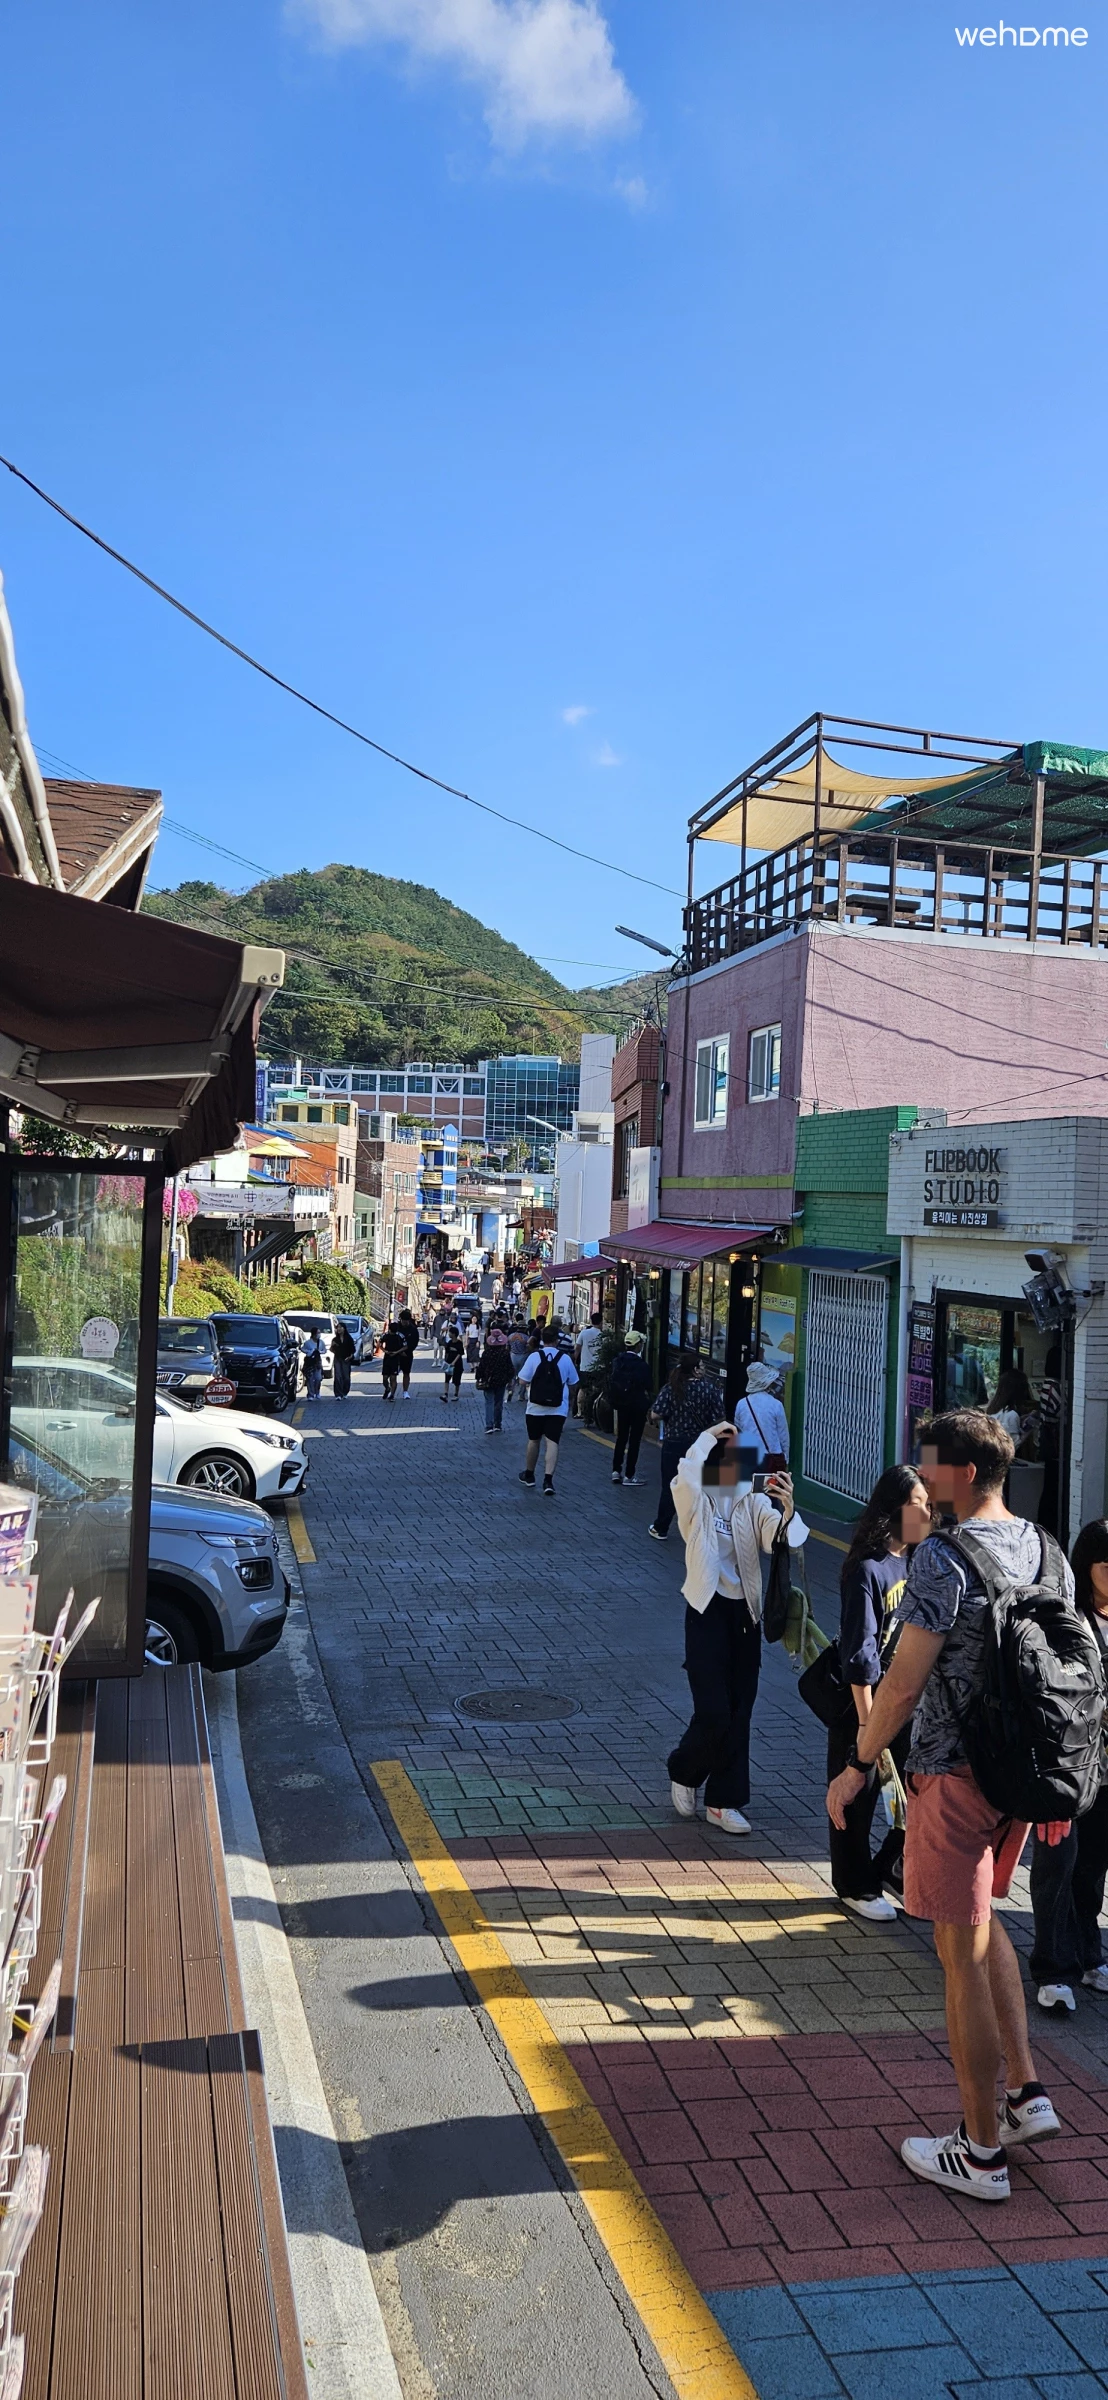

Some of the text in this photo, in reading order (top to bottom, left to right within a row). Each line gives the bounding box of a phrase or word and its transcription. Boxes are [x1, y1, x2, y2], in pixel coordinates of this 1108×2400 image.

[925, 1148, 1000, 1173] FLIPBOOK
[924, 1179, 999, 1204] STUDIO
[932, 1211, 988, 1226] 움직이는 사진상점
[913, 1323, 933, 1341] 특별한
[1027, 2103, 1051, 2116] adida
